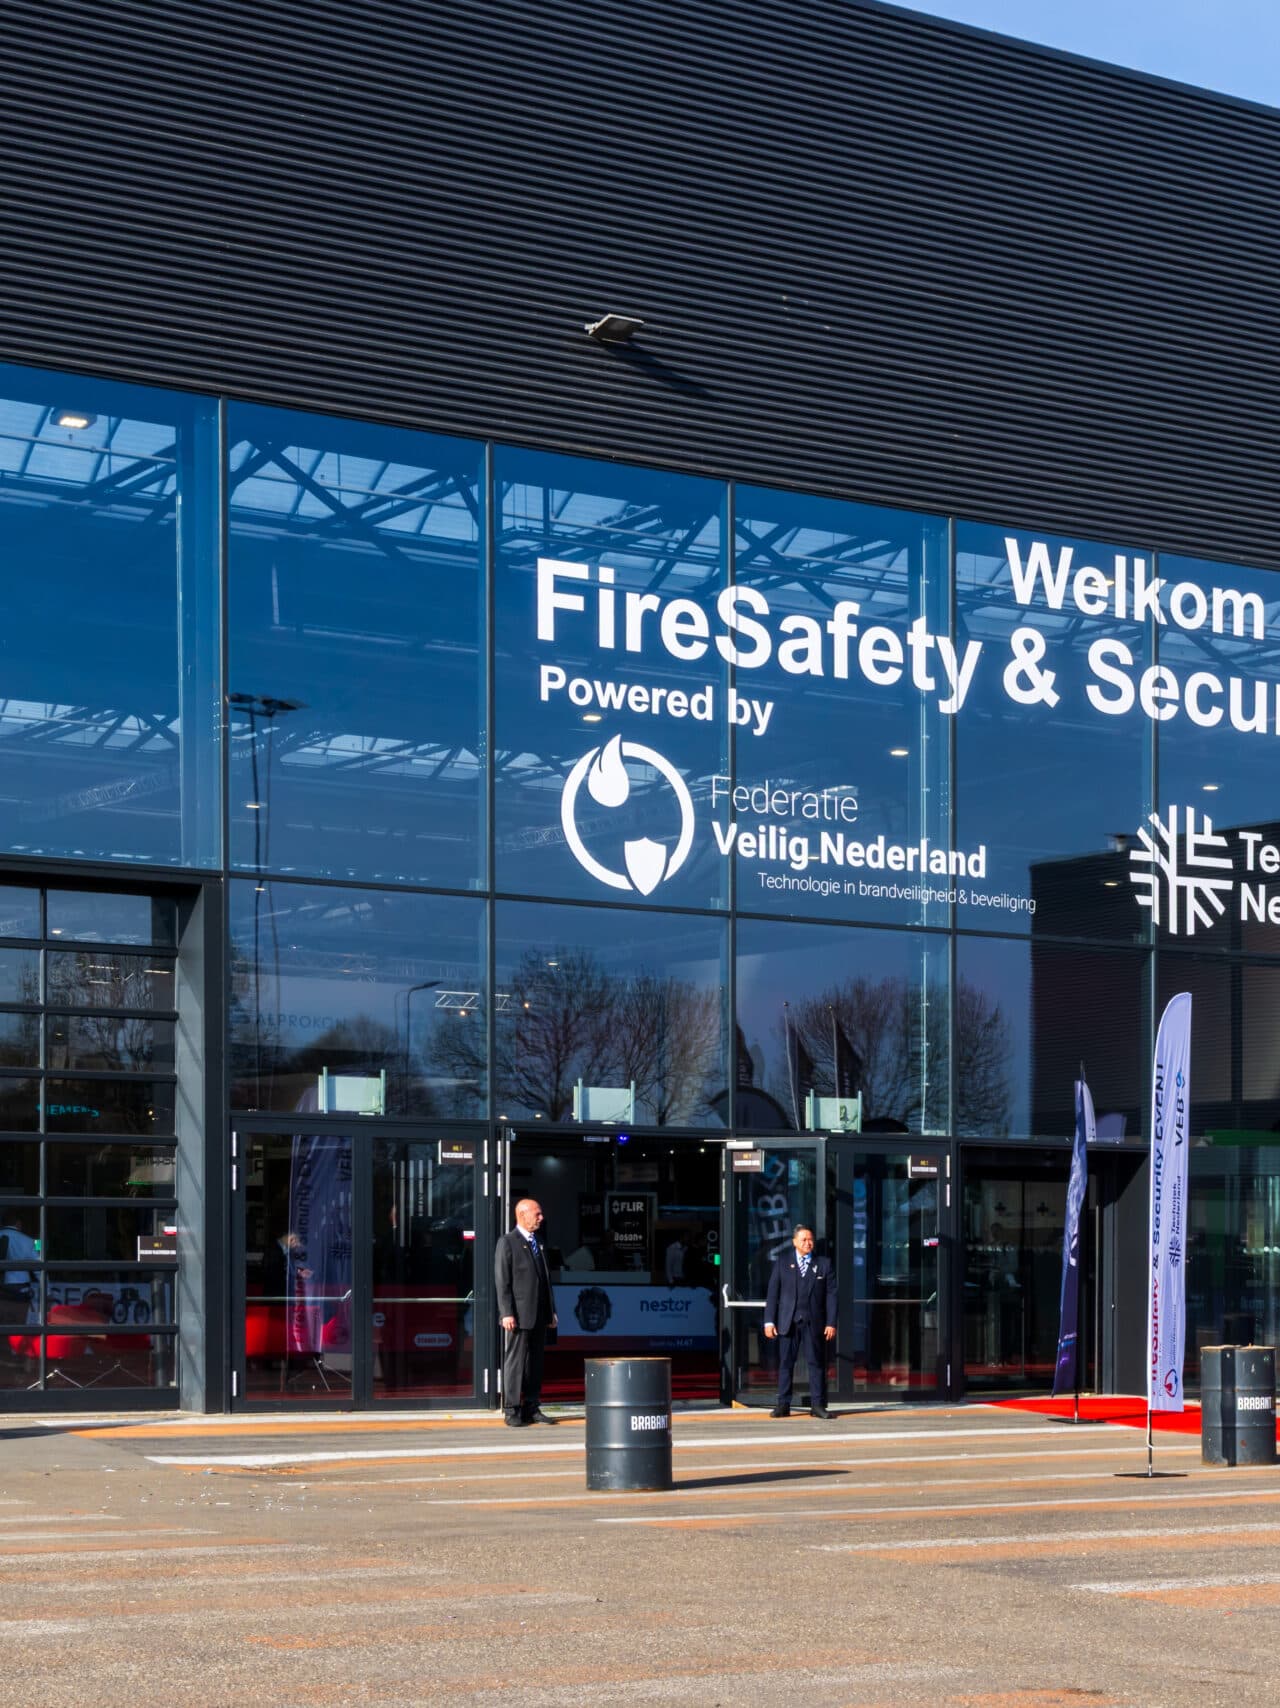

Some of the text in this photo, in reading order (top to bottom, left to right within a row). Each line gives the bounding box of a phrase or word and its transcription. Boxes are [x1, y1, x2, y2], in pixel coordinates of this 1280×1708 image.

[1004, 537, 1265, 640] Welkom
[537, 557, 983, 713] FireSafety
[1003, 627, 1060, 709] &
[540, 664, 773, 736] Powered by
[711, 775, 858, 822] Federatie
[711, 820, 987, 878] Veilig Nederland
[757, 872, 1037, 915] Technologie in brandveiligheid & beveiliging
[620, 1201, 645, 1213] FLIR
[639, 1297, 692, 1312] nestor
[630, 1414, 668, 1431] BRABANT
[1237, 1396, 1272, 1411] BRABANT
